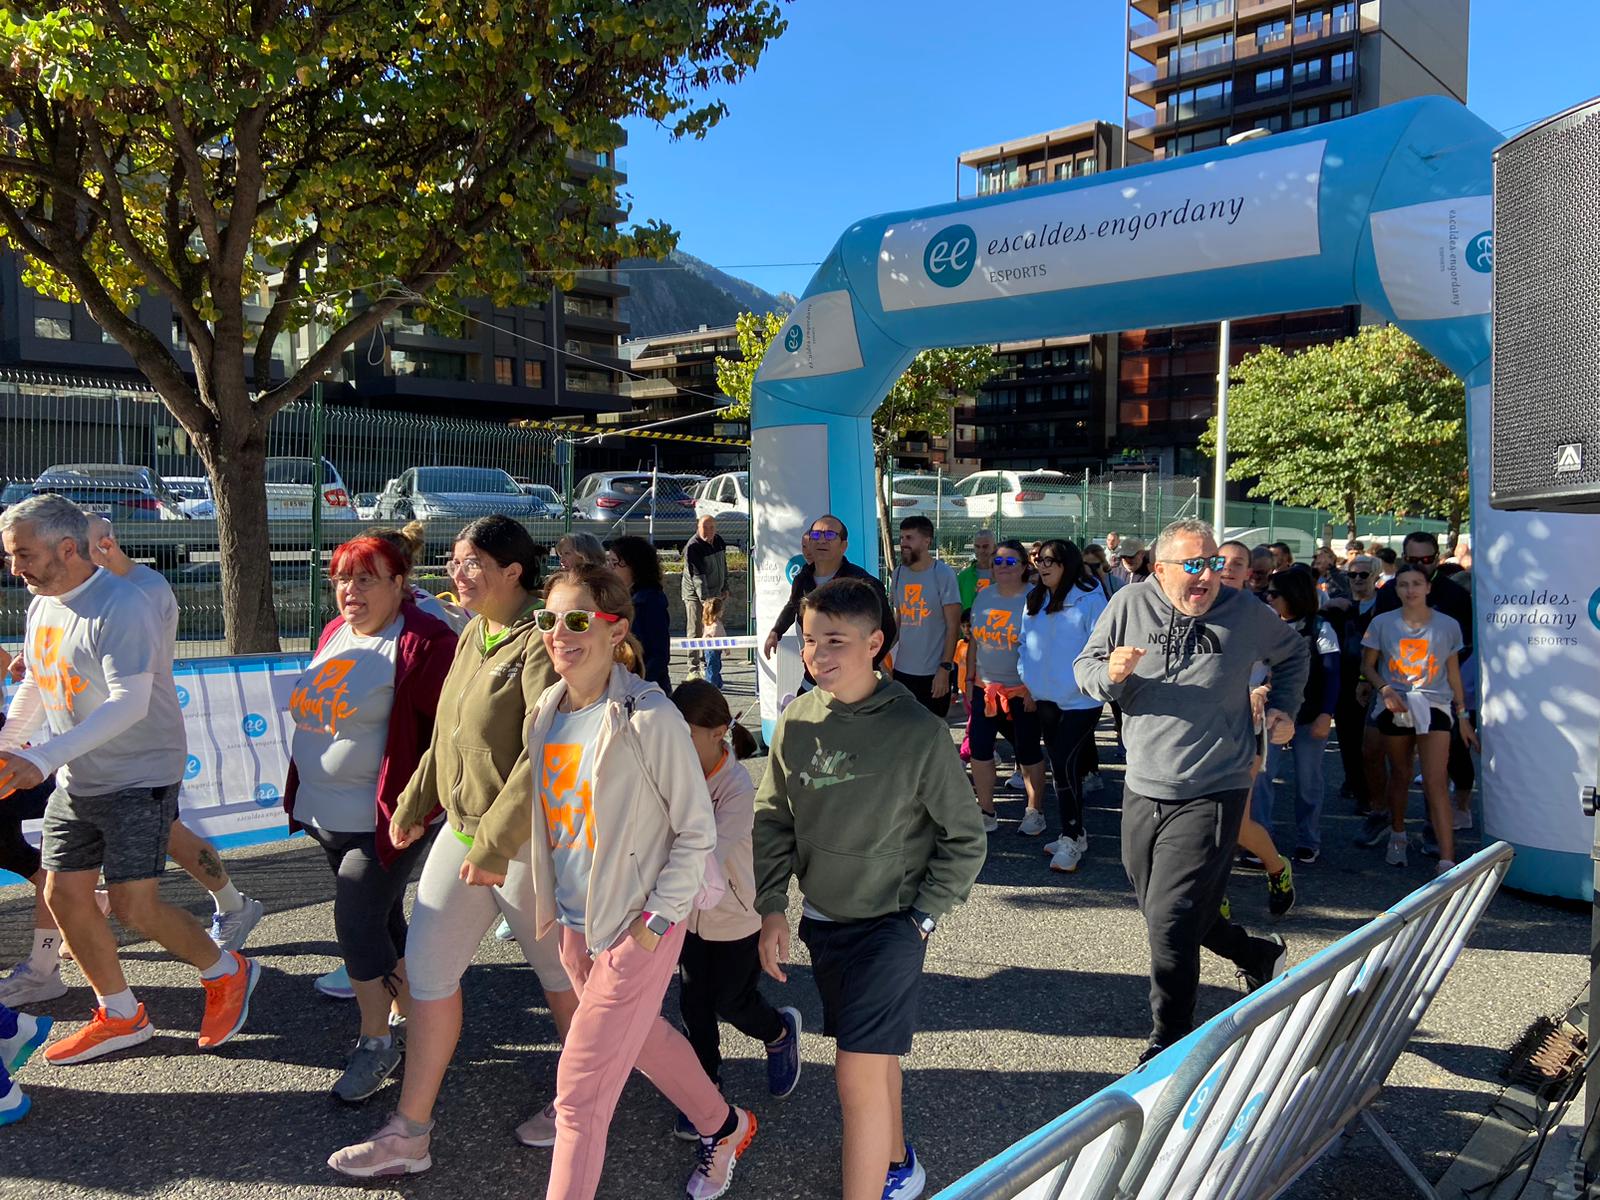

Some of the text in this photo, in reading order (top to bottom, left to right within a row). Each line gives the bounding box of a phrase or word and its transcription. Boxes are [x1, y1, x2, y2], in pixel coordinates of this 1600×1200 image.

[987, 196, 1245, 255] escaldes-engordany
[989, 264, 1047, 283] ESPORTS
[1486, 609, 1577, 630] engordany
[1527, 636, 1578, 646] ESPORTS
